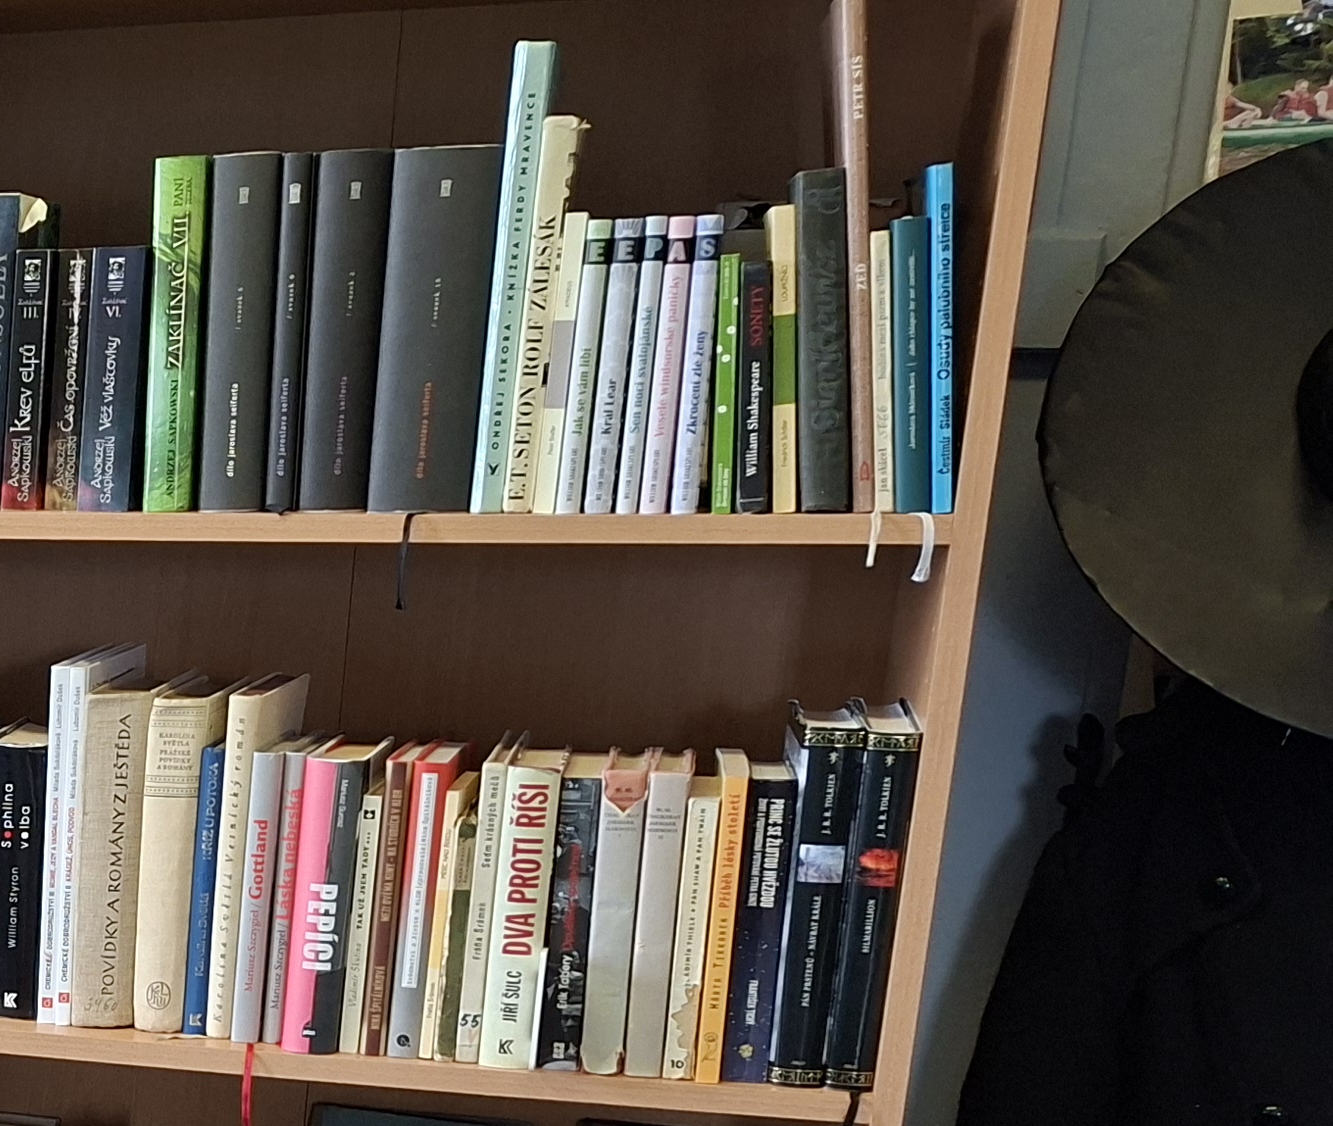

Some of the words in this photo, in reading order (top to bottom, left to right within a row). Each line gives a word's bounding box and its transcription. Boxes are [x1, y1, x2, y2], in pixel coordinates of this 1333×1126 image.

[507, 241, 520, 301] KNÍŽKA
[514, 185, 526, 235] FERDY
[520, 93, 536, 175] MRAVENCE
[173, 214, 190, 249] VII
[528, 215, 556, 313] ZÁLESÁK
[167, 263, 186, 369] ZAKLÍNAČ
[522, 319, 545, 376] ROLF
[168, 380, 178, 445] SAPKOWSKI
[491, 392, 505, 450] ONDŘEJ
[499, 323, 512, 382] SEKORA
[747, 361, 760, 429] Shakespeare
[165, 448, 175, 497] ANDRZEJ
[508, 380, 536, 500] E.T.SETON
[745, 430, 758, 477] William
[114, 713, 132, 790] JEŠTĚDA
[113, 794, 127, 805] Z
[510, 784, 550, 828] ŘÍŠI
[107, 808, 125, 893] ROMÁNY
[248, 819, 269, 899] Gottland
[507, 831, 540, 901] PROTI
[10, 867, 20, 903] Styron
[106, 898, 120, 914] A
[8, 908, 18, 949] William
[101, 916, 120, 995] POVÍDKY
[303, 883, 338, 972] PEPÍCI
[502, 907, 532, 957] DVA
[500, 1002, 518, 1023] JIŘÍ
[505, 971, 521, 998] ŠULC
